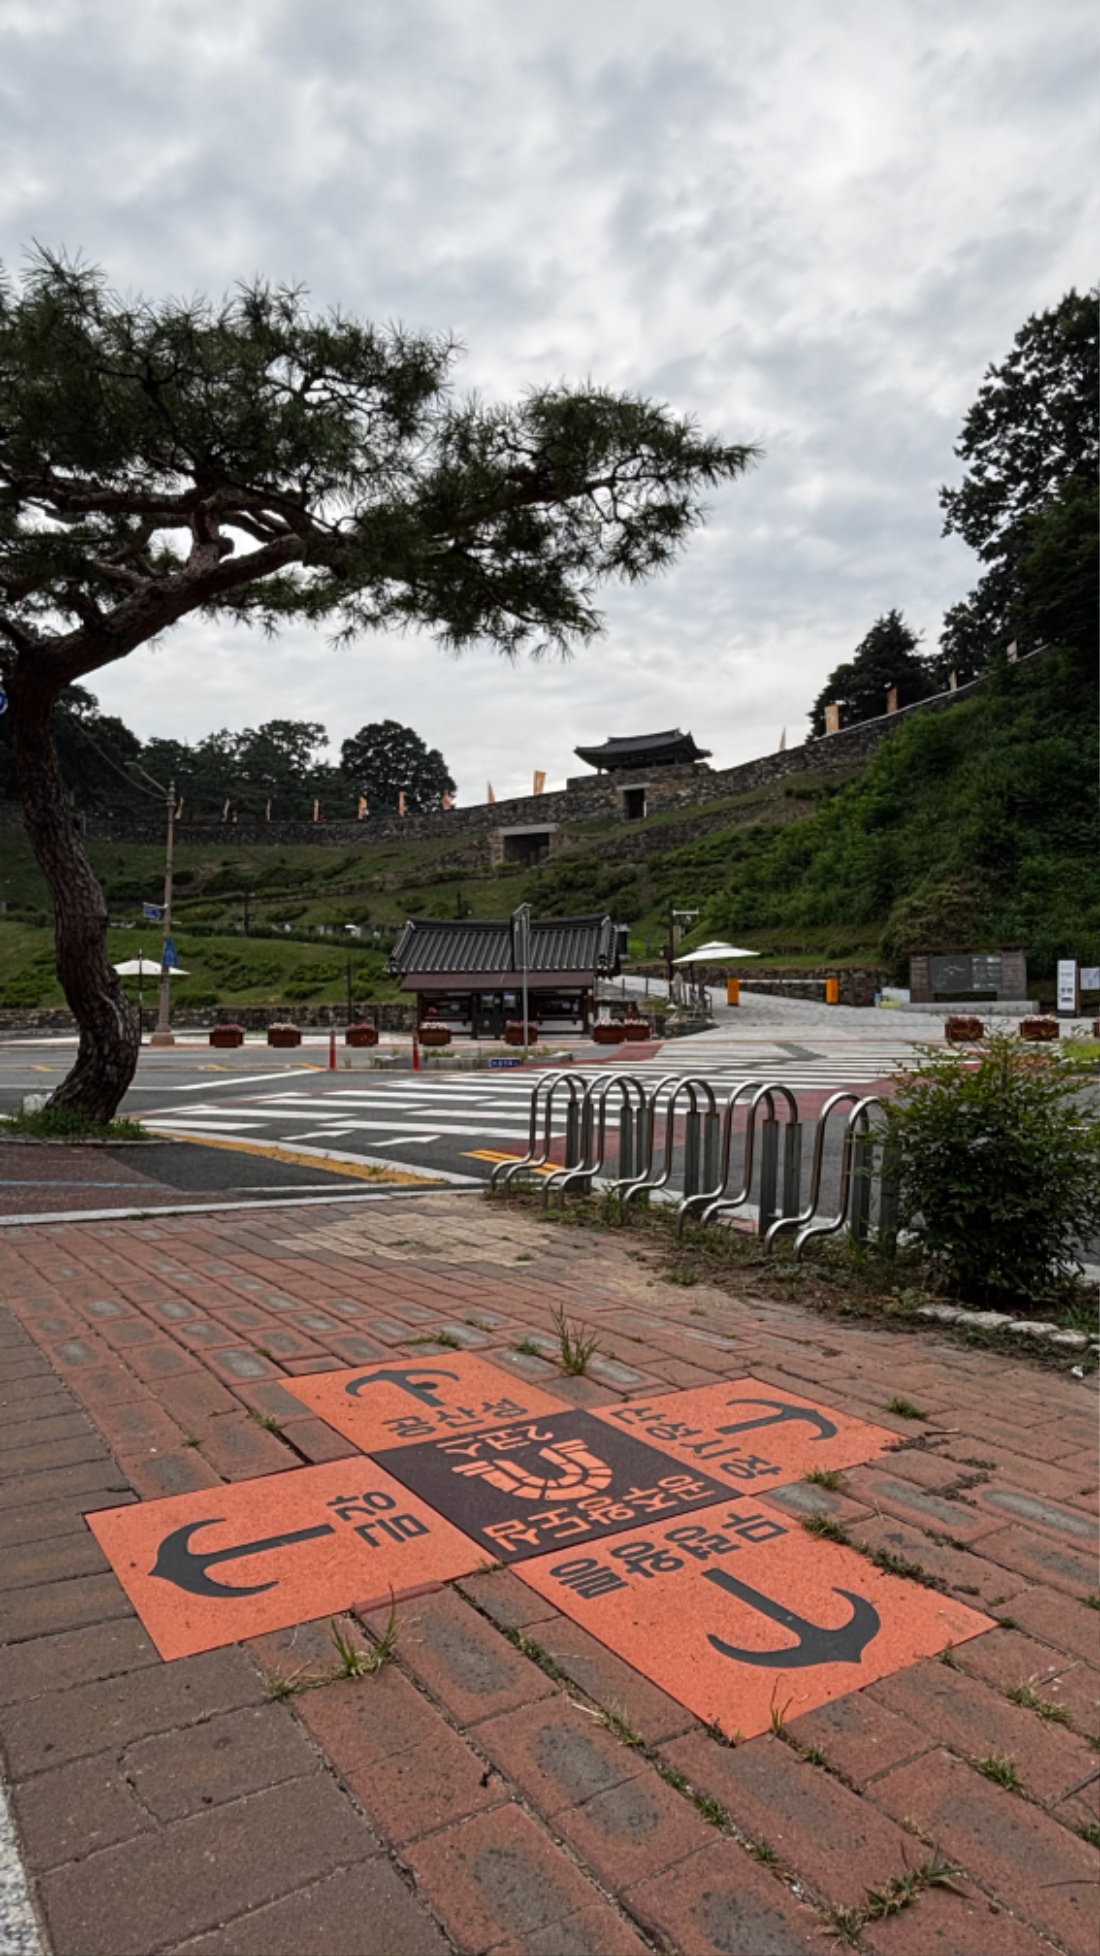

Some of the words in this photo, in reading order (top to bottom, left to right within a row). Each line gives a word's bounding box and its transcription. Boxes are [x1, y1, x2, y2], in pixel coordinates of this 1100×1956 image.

[382, 1398, 528, 1437] 공산성
[436, 1426, 553, 1456] 2코스
[611, 1406, 782, 1480] 산성시장
[326, 1491, 430, 1548] 금강
[549, 1513, 789, 1600] 무령왕릉
